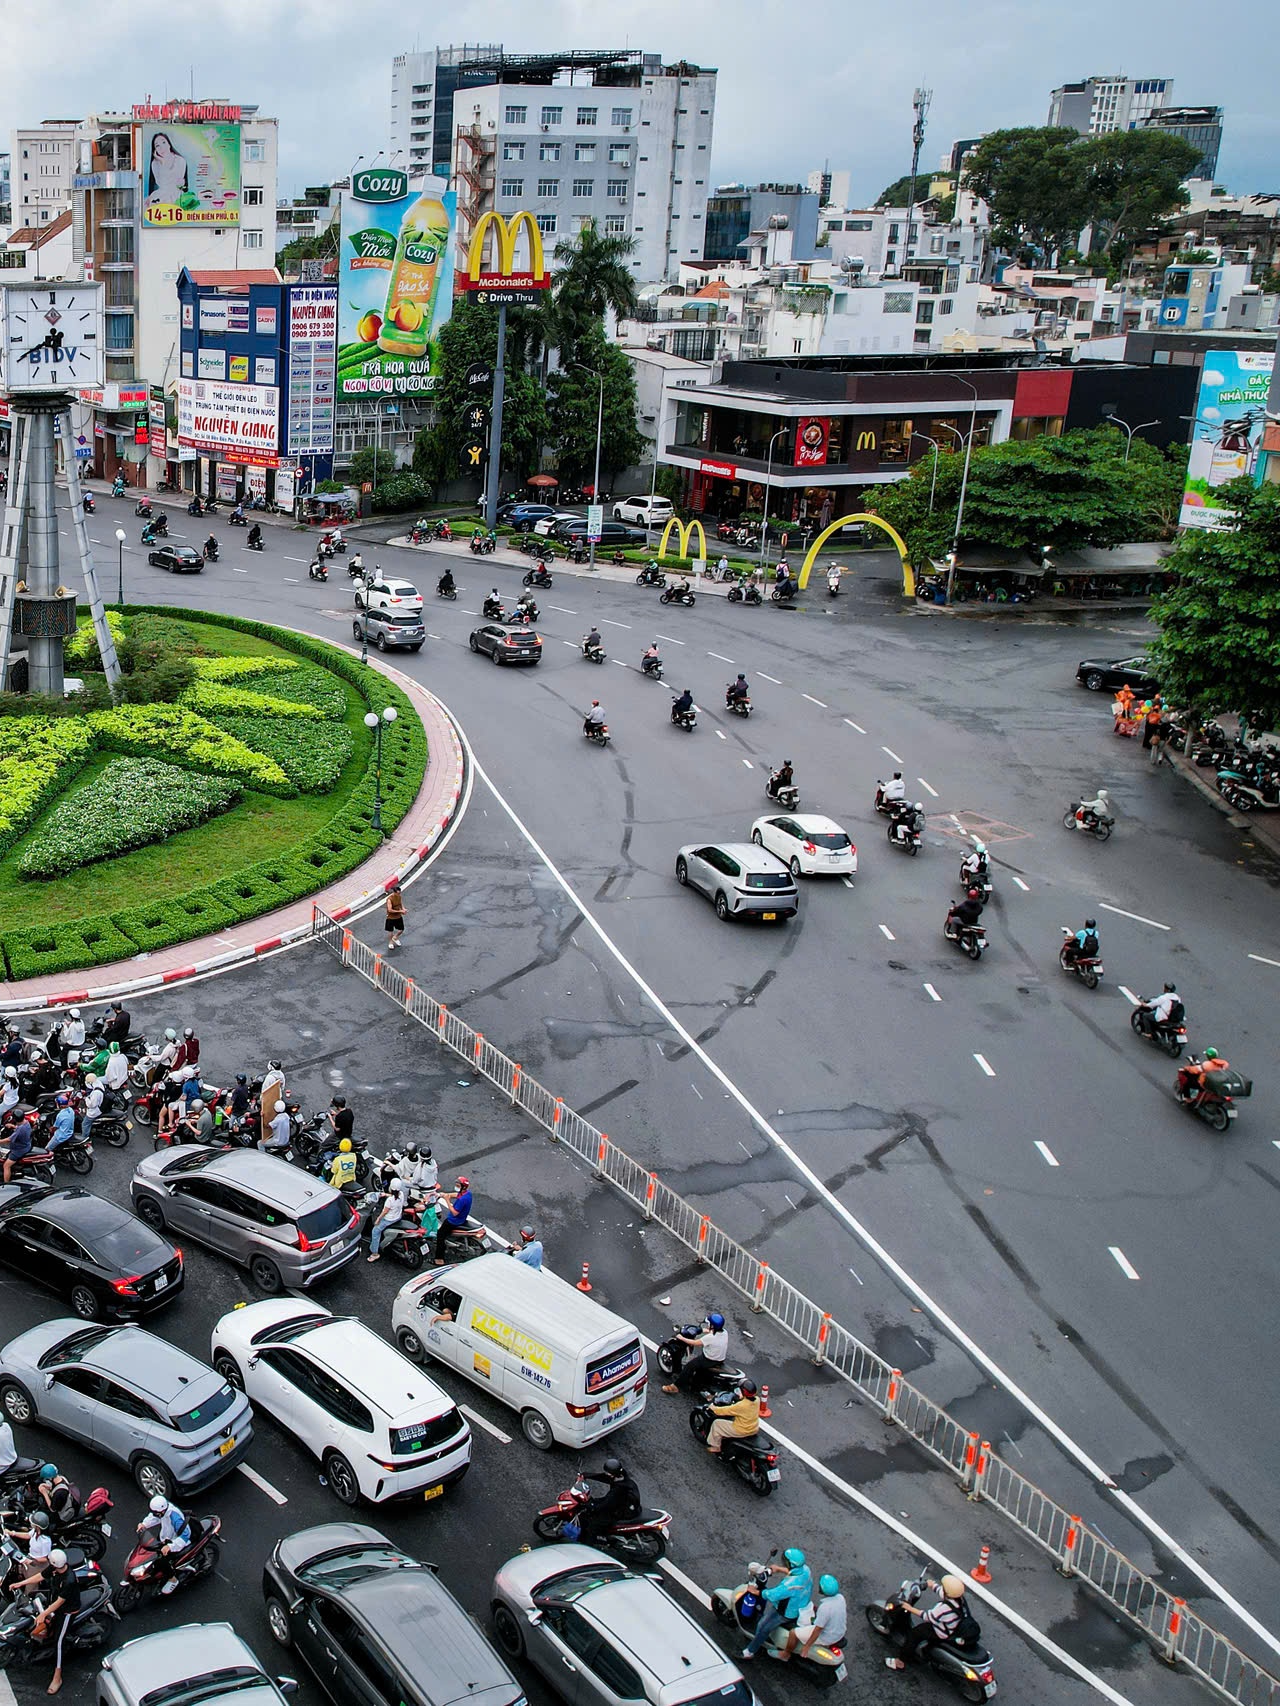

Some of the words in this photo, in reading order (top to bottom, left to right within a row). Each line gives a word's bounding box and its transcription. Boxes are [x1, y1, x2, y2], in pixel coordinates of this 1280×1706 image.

[223, 105, 240, 120] ANH
[357, 174, 402, 196] Cozy
[146, 208, 183, 222] 14-16
[361, 242, 392, 258] Mới
[406, 246, 436, 263] Cozy
[478, 278, 533, 286] McDonald's
[490, 293, 513, 302] Drive
[515, 293, 533, 301] Thru
[200, 310, 226, 318] Panasonic
[309, 322, 321, 330] 679
[291, 330, 308, 338] 0909
[30, 346, 77, 364] BIDV
[362, 358, 381, 376] TRÀ
[385, 361, 405, 374] HOA
[409, 355, 430, 374] QUẢ
[315, 383, 329, 391] LS
[344, 379, 367, 392] NGON
[247, 395, 258, 403] LED
[1220, 390, 1241, 402] NHÀ
[194, 413, 238, 436] NGUYỄN
[242, 422, 275, 440] GIANG
[340, 1160, 355, 1171] be
[602, 1357, 632, 1379] Ahamove
[520, 1365, 552, 1389] 61H-142.76
